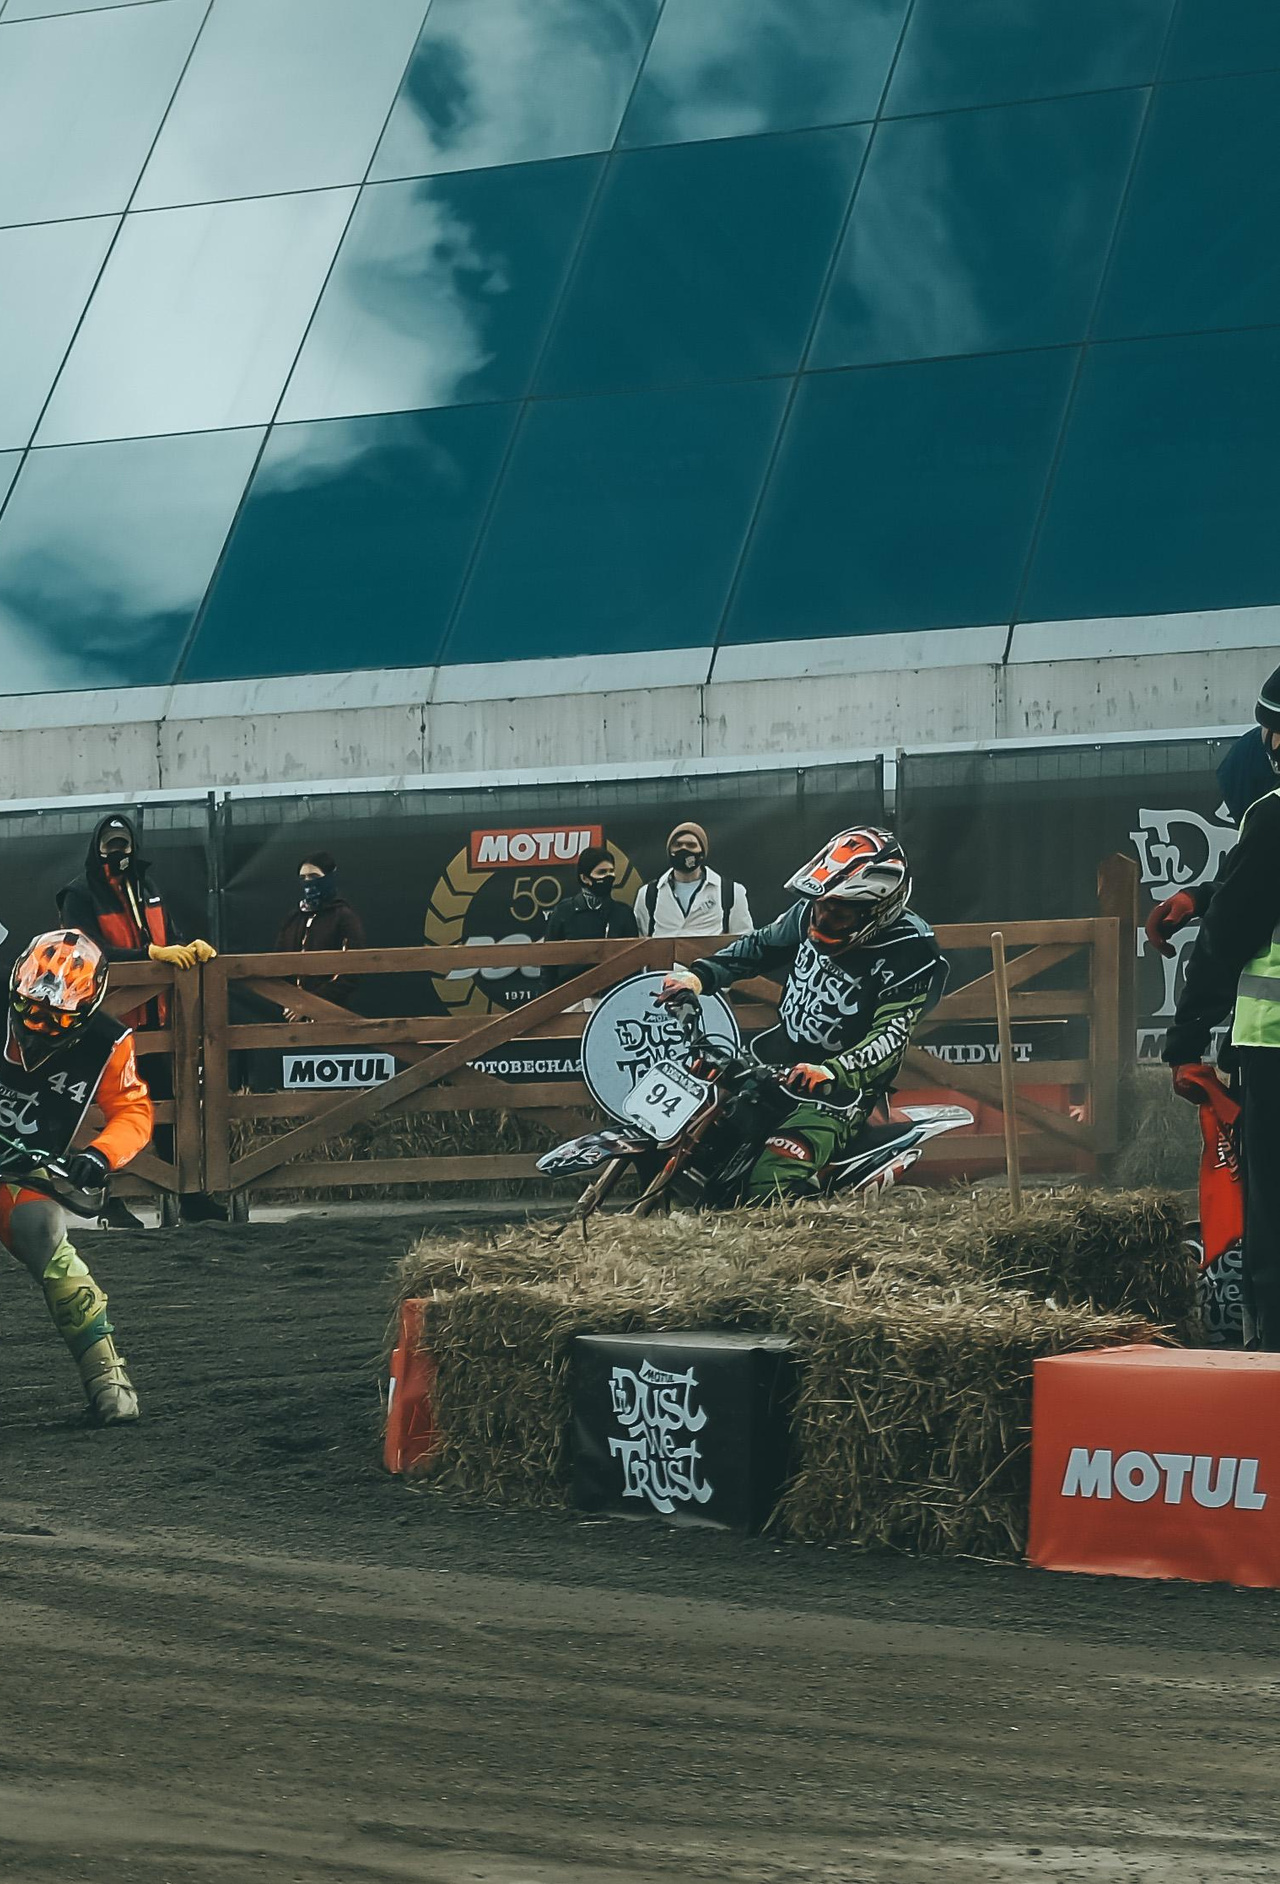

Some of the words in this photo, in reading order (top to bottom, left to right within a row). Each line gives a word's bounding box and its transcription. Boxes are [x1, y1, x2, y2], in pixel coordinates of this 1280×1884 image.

[510, 875, 562, 921] 50
[505, 991, 531, 1000] 1971
[48, 1071, 87, 1103] 44
[289, 1059, 390, 1083] MOTUL
[646, 1084, 682, 1118] 94
[612, 1358, 708, 1432] Dust
[628, 1420, 677, 1460] We
[607, 1437, 713, 1514] Trust
[1061, 1447, 1268, 1510] MOTUL
